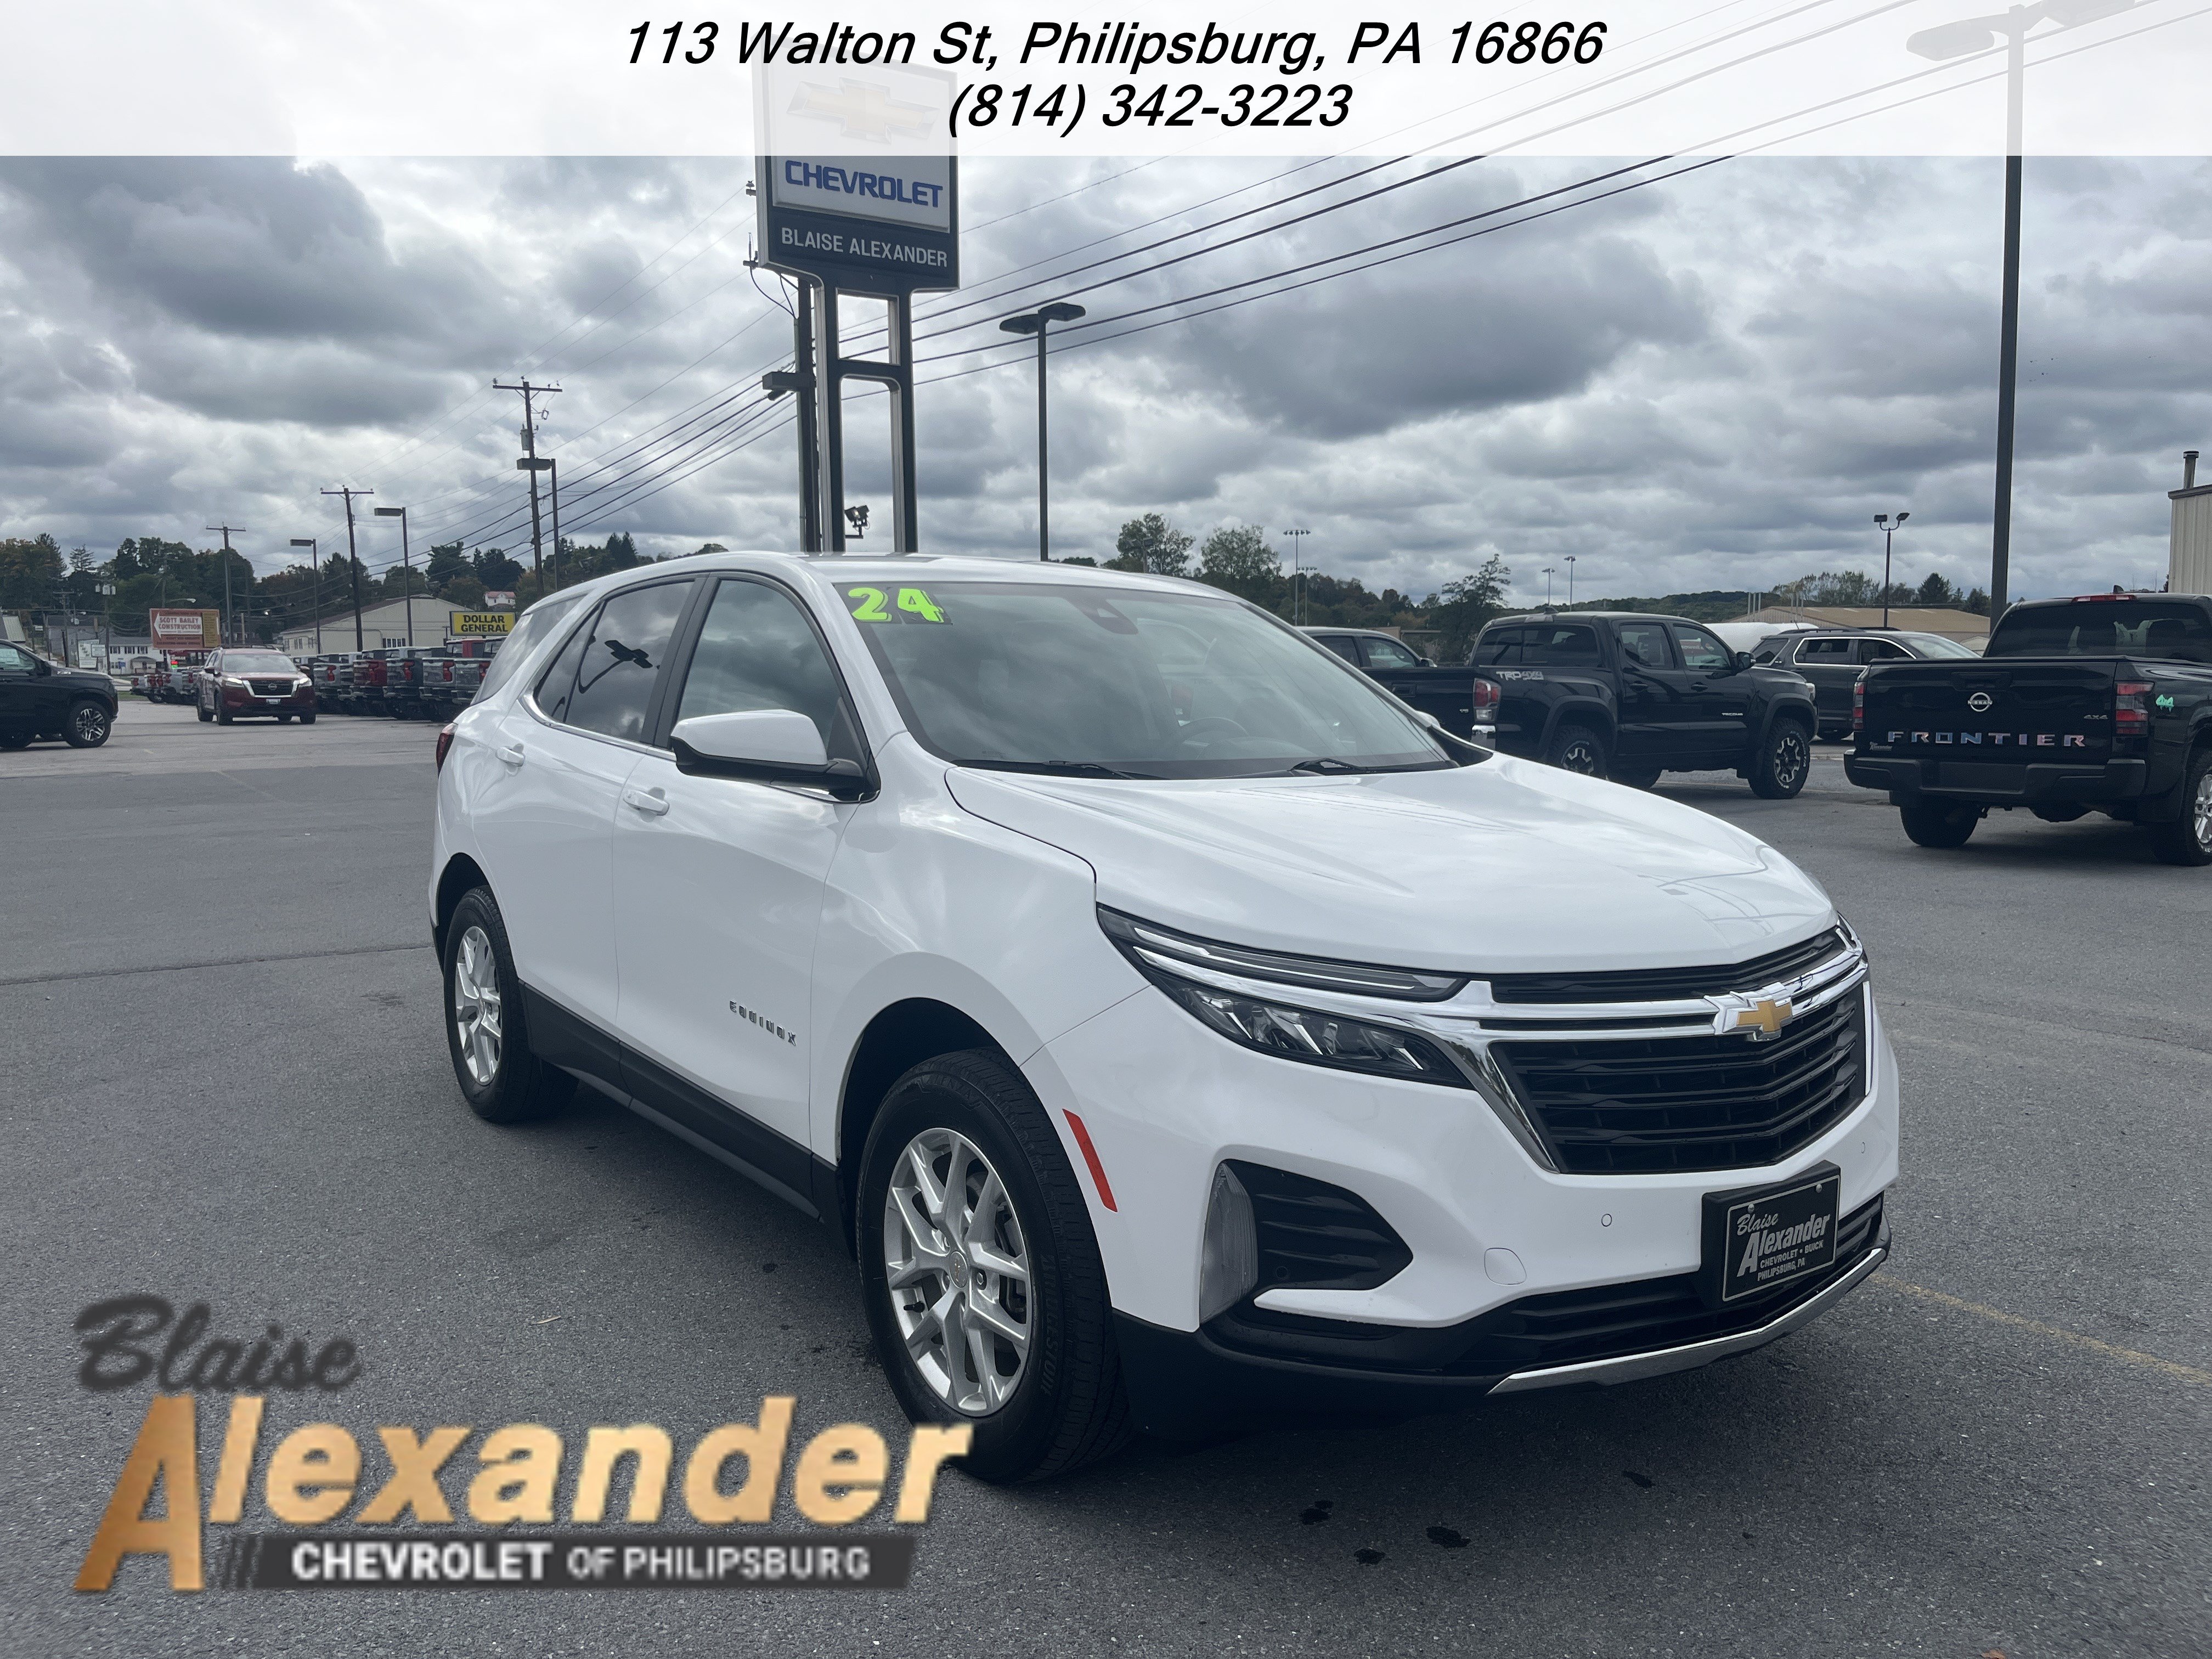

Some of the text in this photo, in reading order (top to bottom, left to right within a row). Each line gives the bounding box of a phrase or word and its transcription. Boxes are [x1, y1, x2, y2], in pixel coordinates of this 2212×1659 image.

[785, 160, 943, 208] CHEVROLET
[781, 227, 948, 268] BLAISE ALEXANDER
[463, 615, 505, 623] DOLLAR
[848, 587, 945, 623] 24
[461, 624, 508, 632] GENERAL
[1888, 731, 2085, 747] FRONTIER
[729, 1000, 797, 1046] EQUINOX
[1737, 1214, 1779, 1236] Blaise
[1736, 1214, 1831, 1277] Alexander
[1760, 1239, 1824, 1269] CHEVROLET BUICK
[1797, 1257, 1805, 1268] PA
